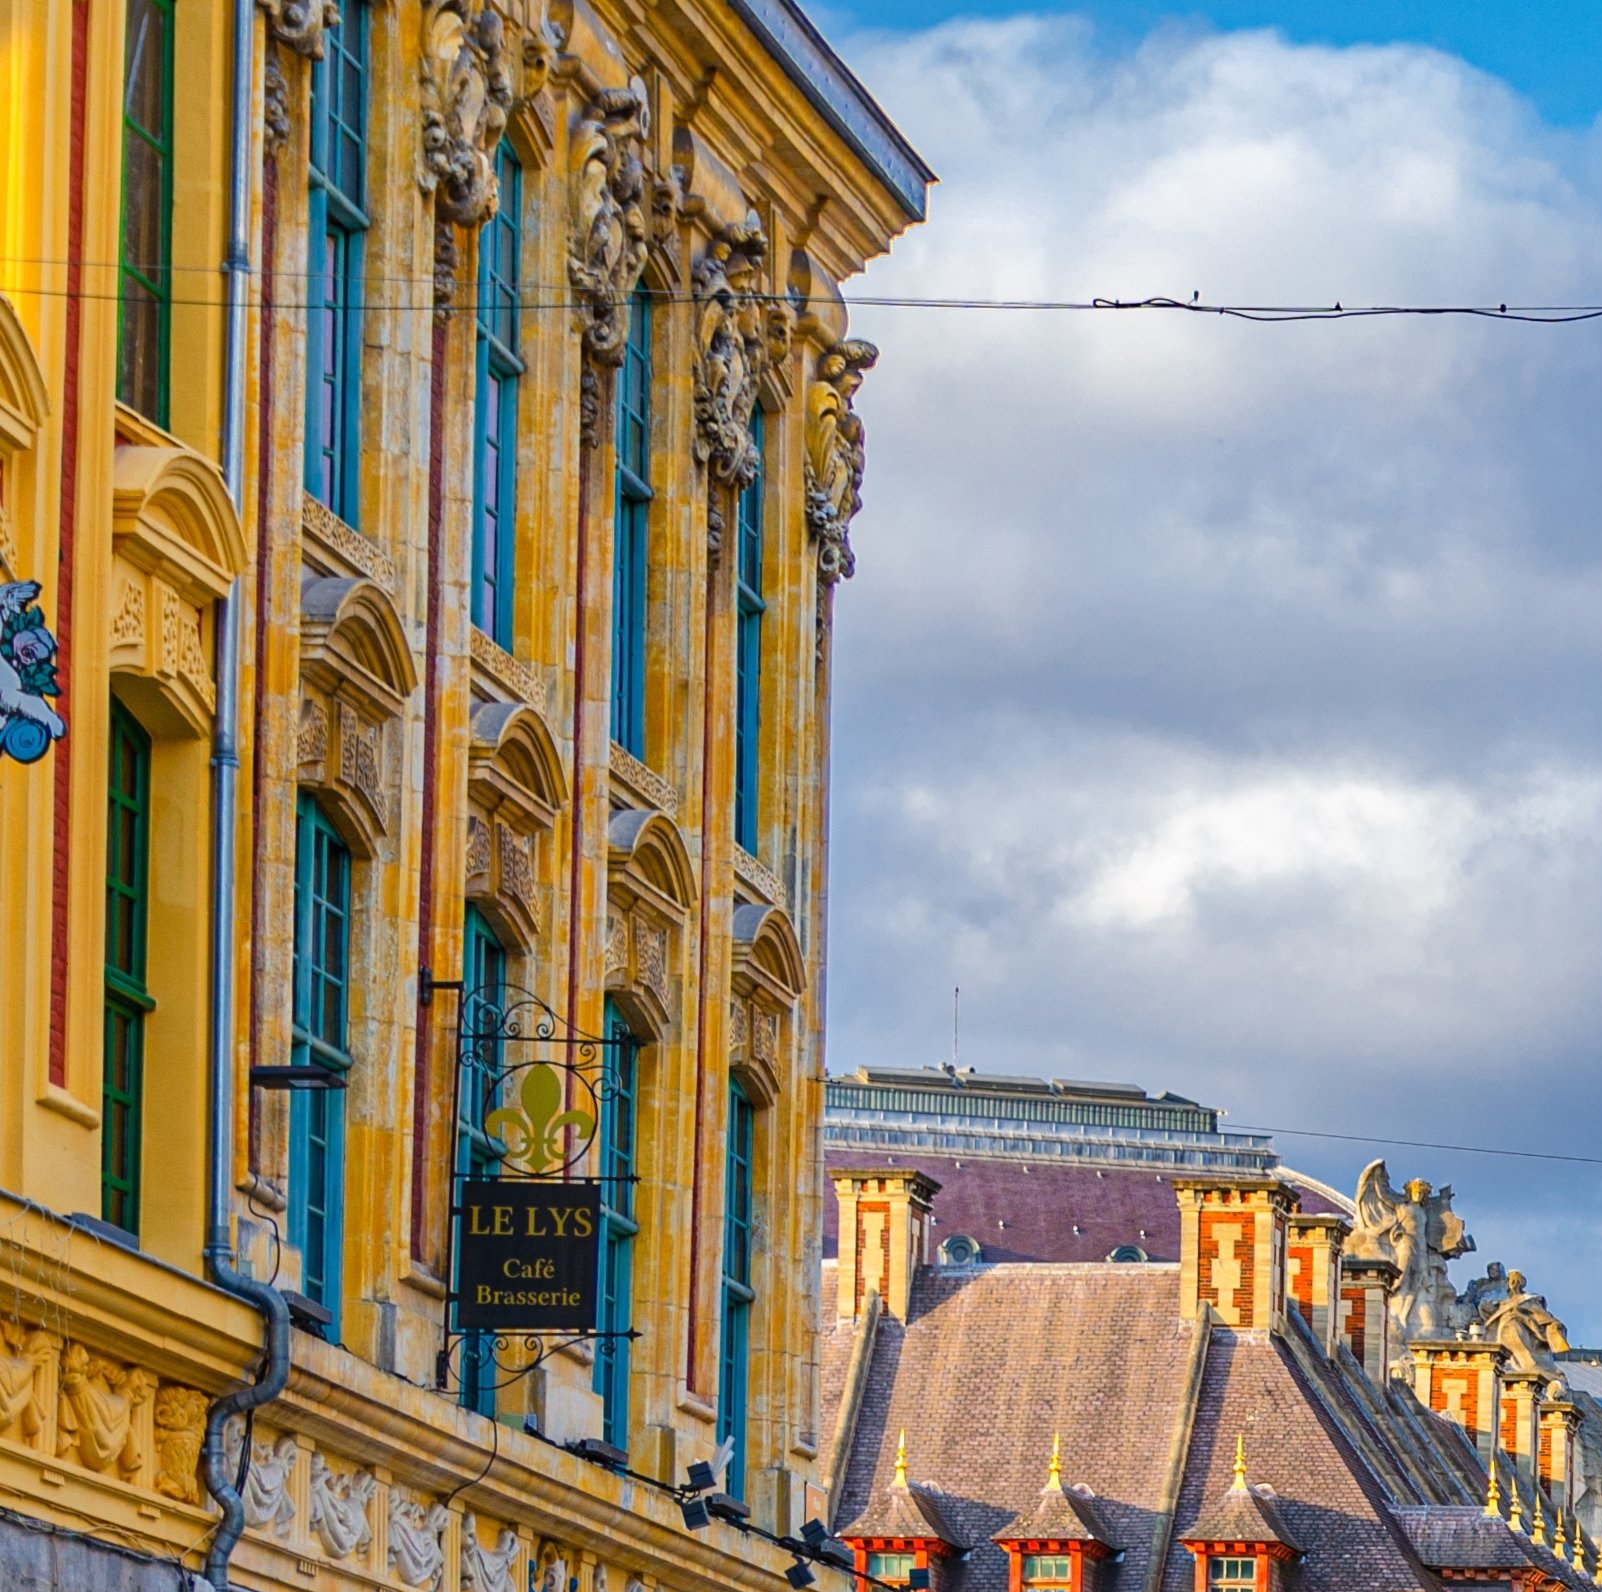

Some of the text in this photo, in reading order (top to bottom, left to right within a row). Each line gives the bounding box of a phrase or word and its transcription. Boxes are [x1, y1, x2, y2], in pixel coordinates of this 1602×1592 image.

[468, 1205, 593, 1237] LE LYS
[503, 1258, 555, 1279] Café
[475, 1285, 581, 1306] Brasserie
